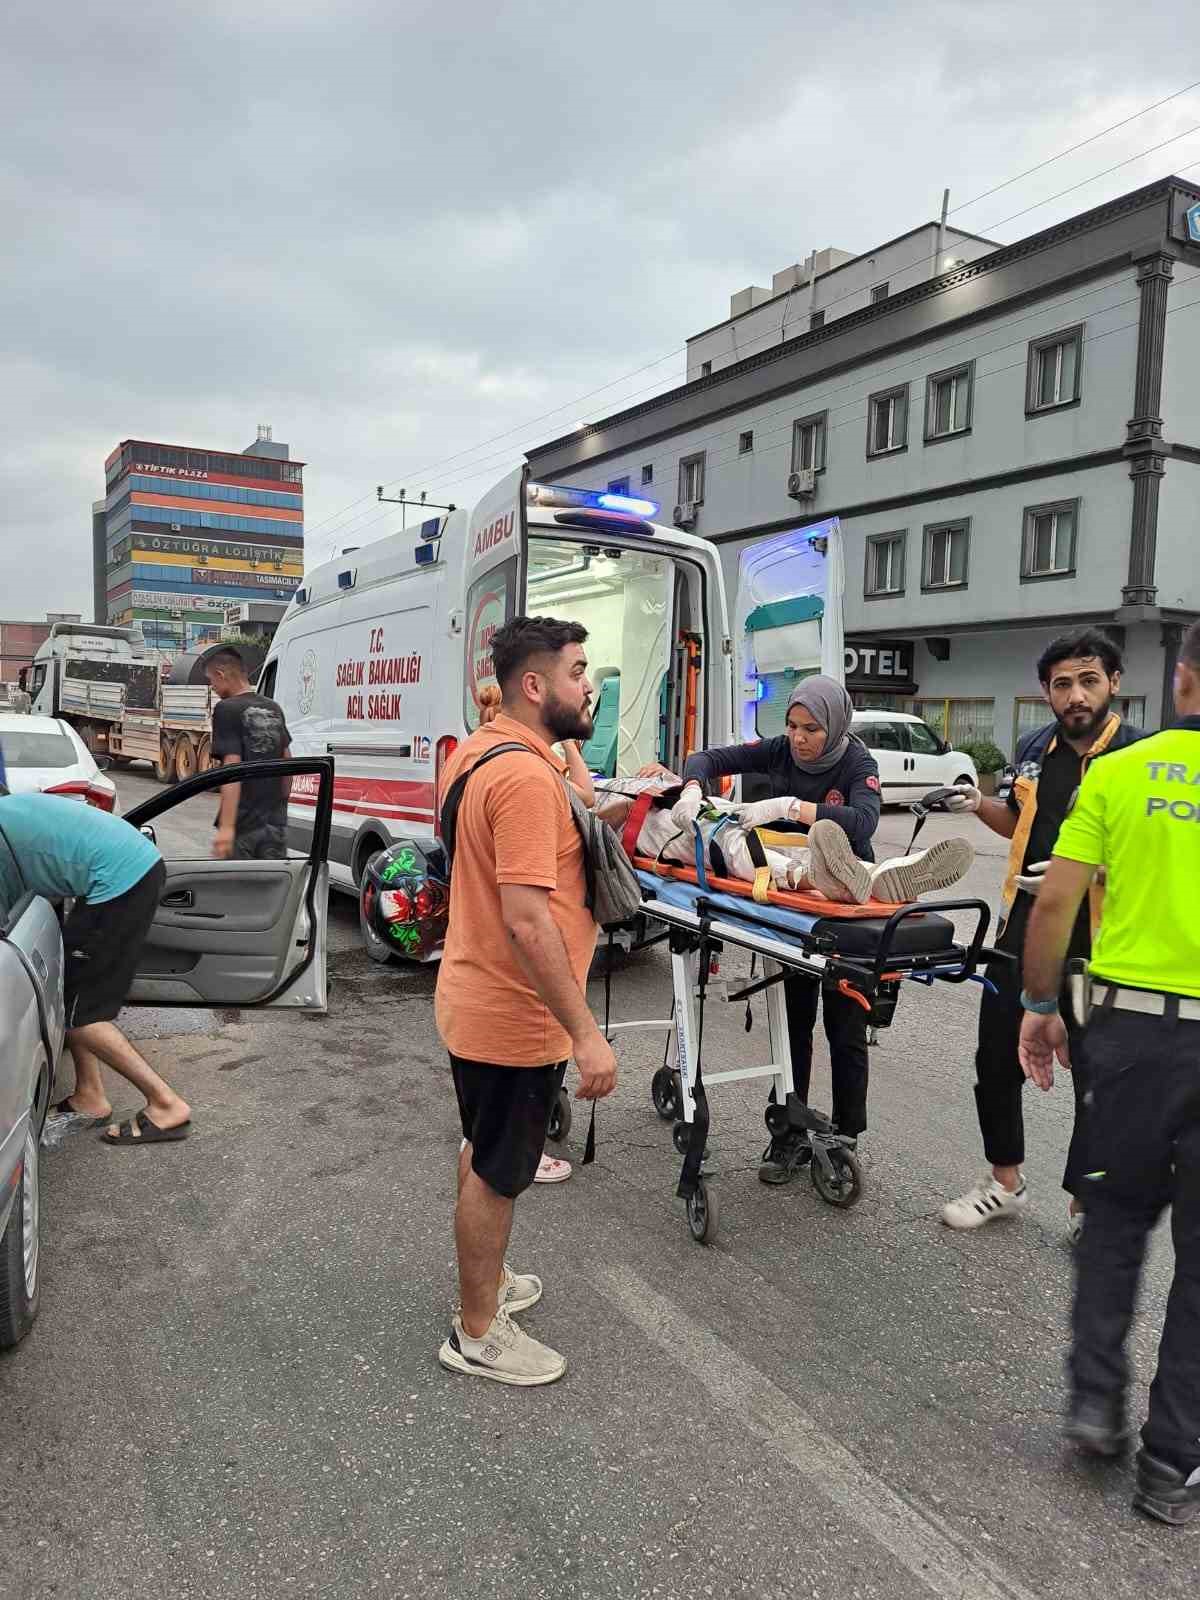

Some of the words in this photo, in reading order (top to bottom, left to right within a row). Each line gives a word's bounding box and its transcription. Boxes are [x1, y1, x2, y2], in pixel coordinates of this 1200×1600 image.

[178, 468, 208, 479] PLAZA
[473, 511, 515, 559] AMBU
[369, 627, 385, 654] T.C.
[336, 658, 365, 688] SAĞLIK
[368, 650, 422, 686] BAKANLIĞI
[346, 690, 365, 720] ACİL
[367, 689, 402, 721] SAĞLIK
[413, 735, 431, 759] 112
